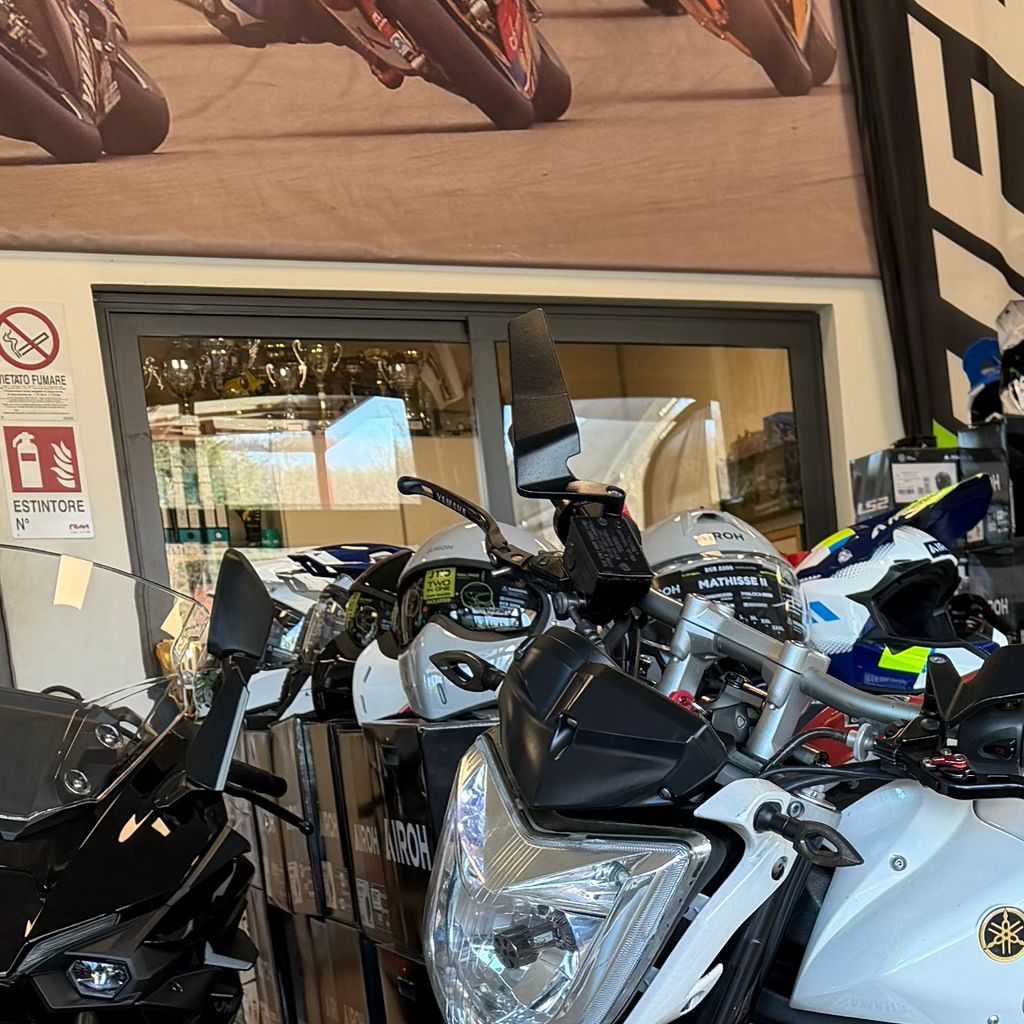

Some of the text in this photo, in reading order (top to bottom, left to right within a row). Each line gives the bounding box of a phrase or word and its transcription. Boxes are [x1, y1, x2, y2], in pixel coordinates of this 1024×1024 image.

[32, 375, 66, 385] FUMARE
[13, 500, 85, 512] ESTINTORE
[857, 496, 889, 515] LS2
[698, 576, 759, 590] MATHISSE
[354, 824, 380, 856] AIROH
[384, 818, 432, 871] AIROH
